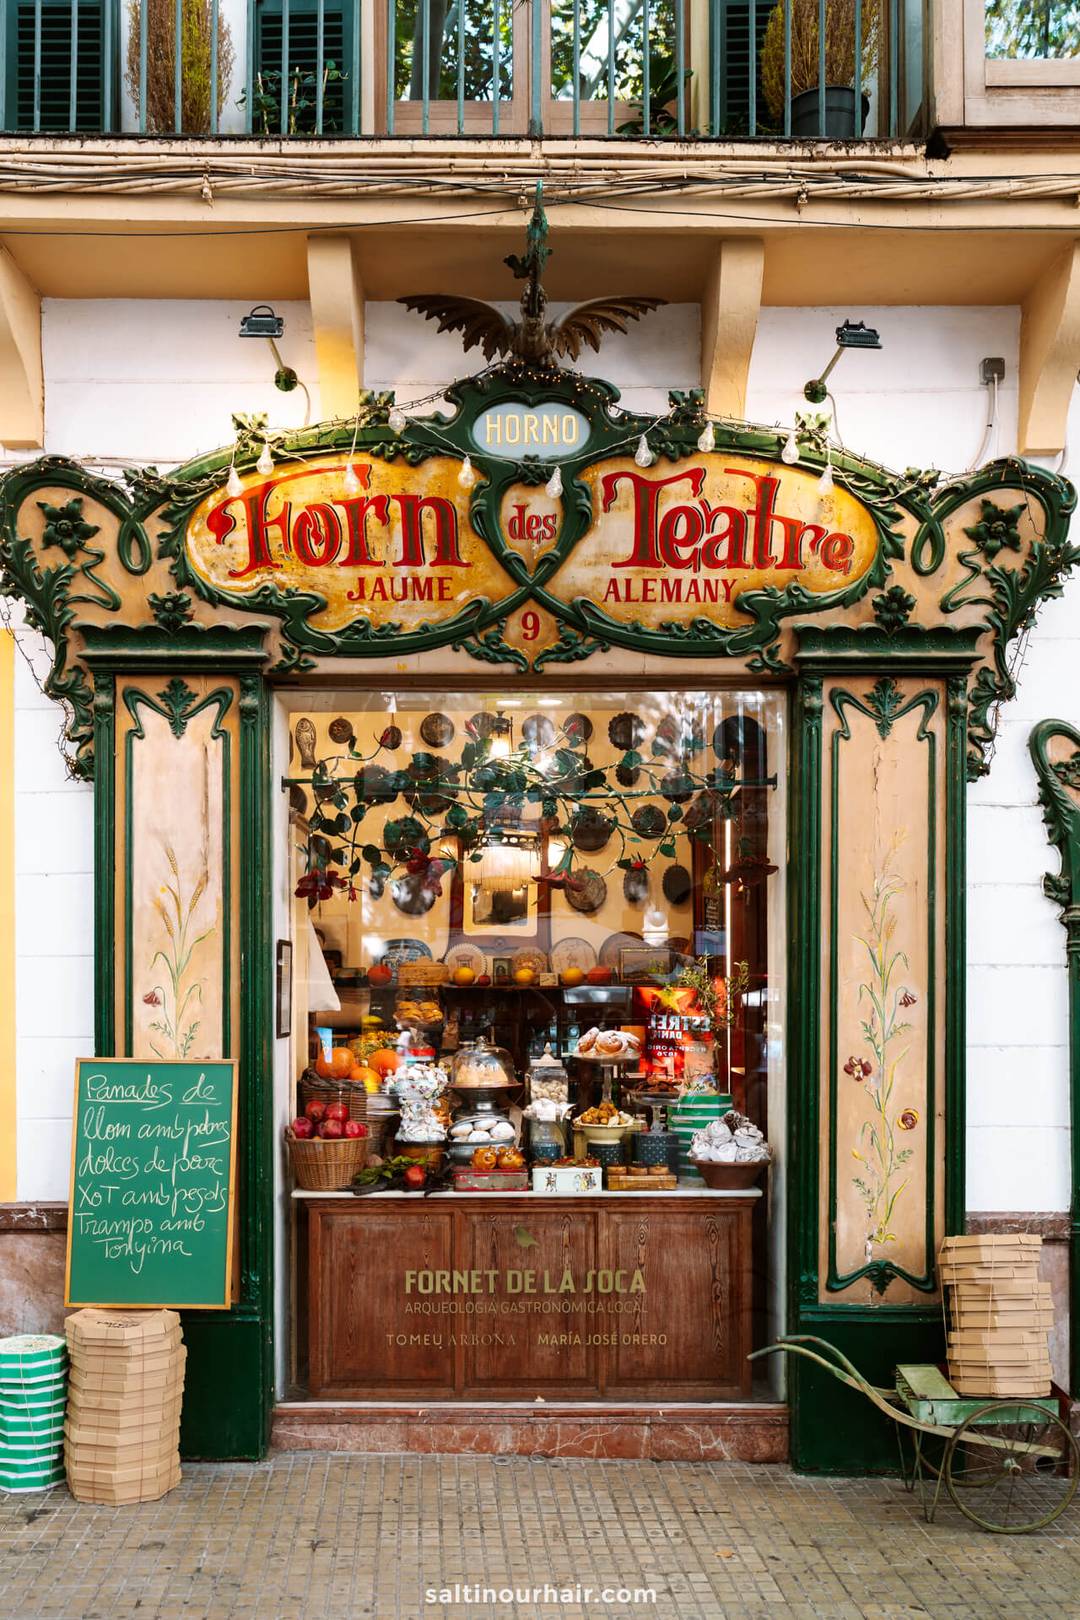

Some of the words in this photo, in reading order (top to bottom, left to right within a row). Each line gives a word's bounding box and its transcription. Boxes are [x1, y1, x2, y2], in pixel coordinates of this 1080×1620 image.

[486, 414, 579, 444] HORNO
[206, 464, 472, 577] Forn
[508, 504, 557, 544] des
[602, 467, 854, 575] Teatre
[347, 576, 453, 601] JAUME
[604, 578, 737, 603] ALEMANY
[521, 611, 540, 641] 9
[85, 1074, 172, 1110] Panades
[182, 1073, 217, 1100] de
[138, 1113, 184, 1138] amb
[79, 1142, 139, 1179] dolces
[144, 1146, 170, 1173] de
[172, 1153, 223, 1186] porc
[122, 1183, 170, 1205] amb
[171, 1180, 227, 1218] pesols
[75, 1213, 153, 1252] Trampo
[160, 1214, 205, 1231] amb
[94, 1236, 192, 1274] Tonyina
[405, 1270, 498, 1294] FORNET
[506, 1269, 536, 1294] DE
[544, 1269, 576, 1294] LA
[583, 1269, 647, 1294] SOCA
[608, 1301, 648, 1314] LOCAL
[386, 1334, 443, 1345] TOMEU
[448, 1334, 516, 1345] ARBONA
[538, 1332, 581, 1345] MARÍA
[586, 1332, 618, 1345] JOSÉ
[622, 1334, 667, 1345] ORERO
